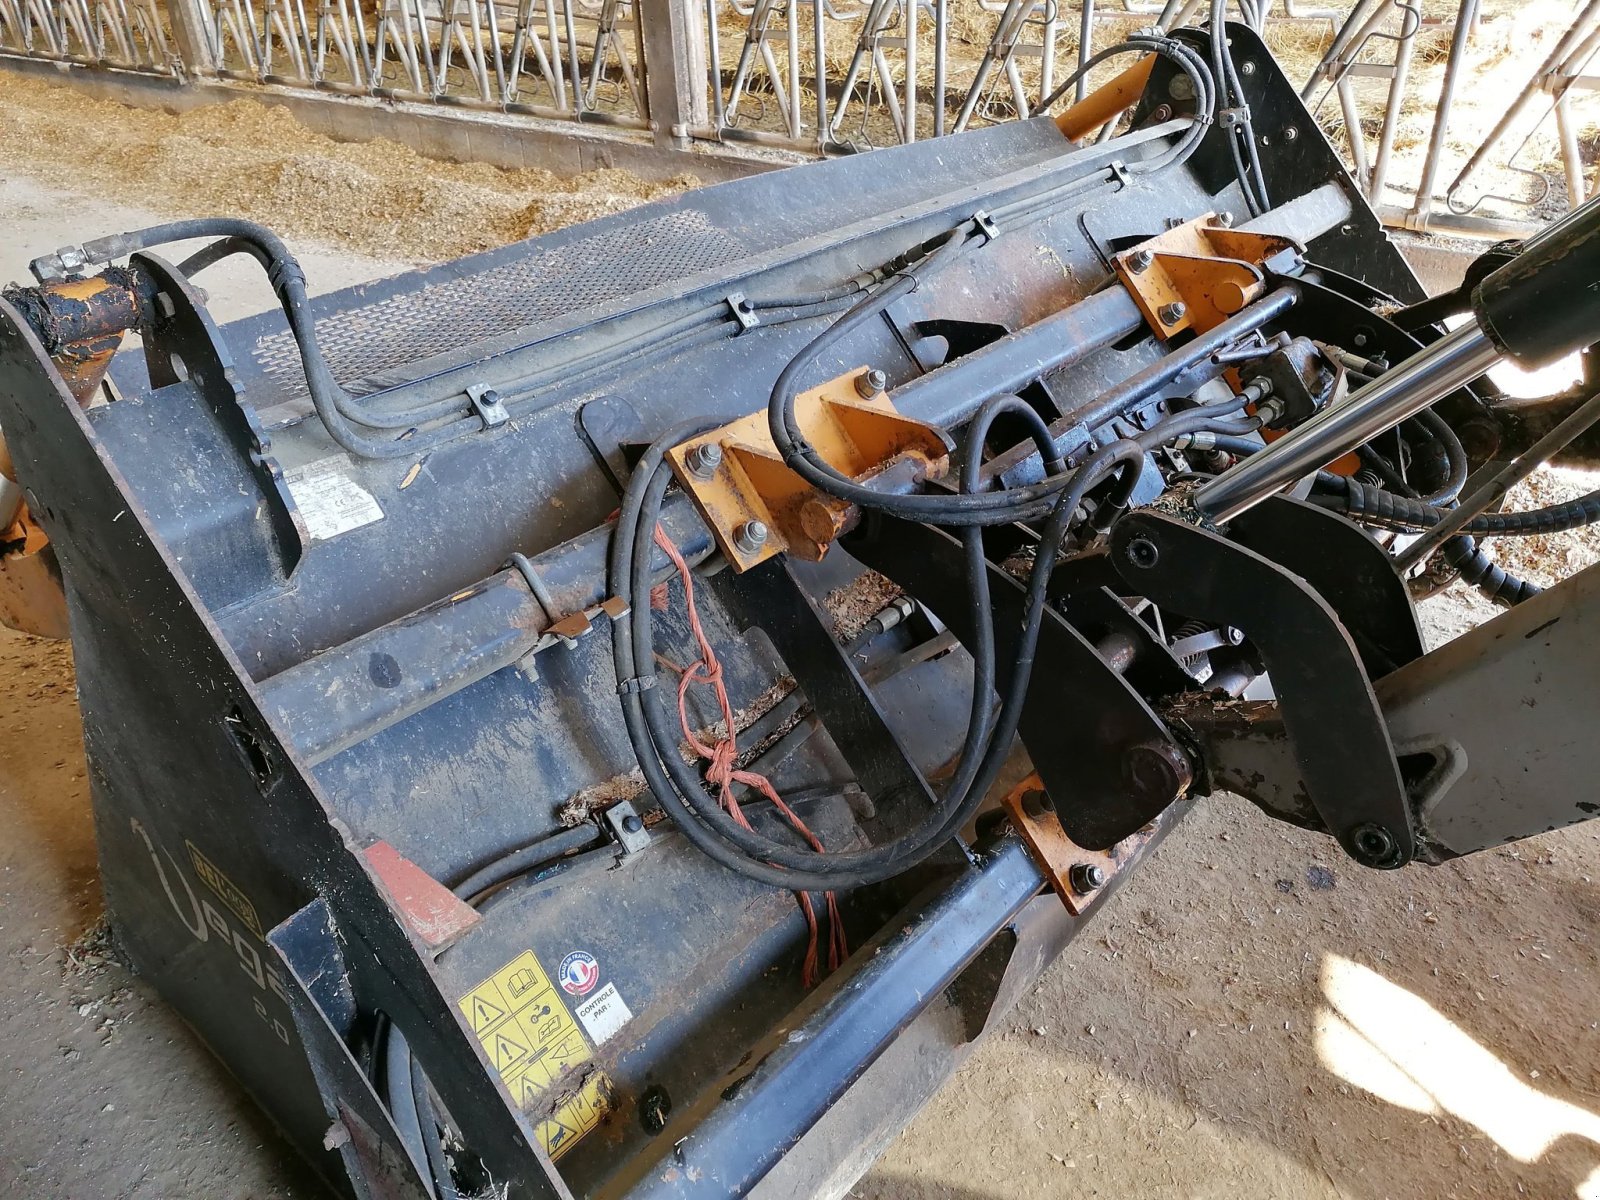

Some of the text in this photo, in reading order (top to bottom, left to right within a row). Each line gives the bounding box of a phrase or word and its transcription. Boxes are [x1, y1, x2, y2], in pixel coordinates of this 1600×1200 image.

[561, 963, 569, 979] MADE
[571, 953, 592, 962] FRANCE
[580, 987, 615, 1017] CONTROLE
[253, 996, 290, 1046] 2.0
